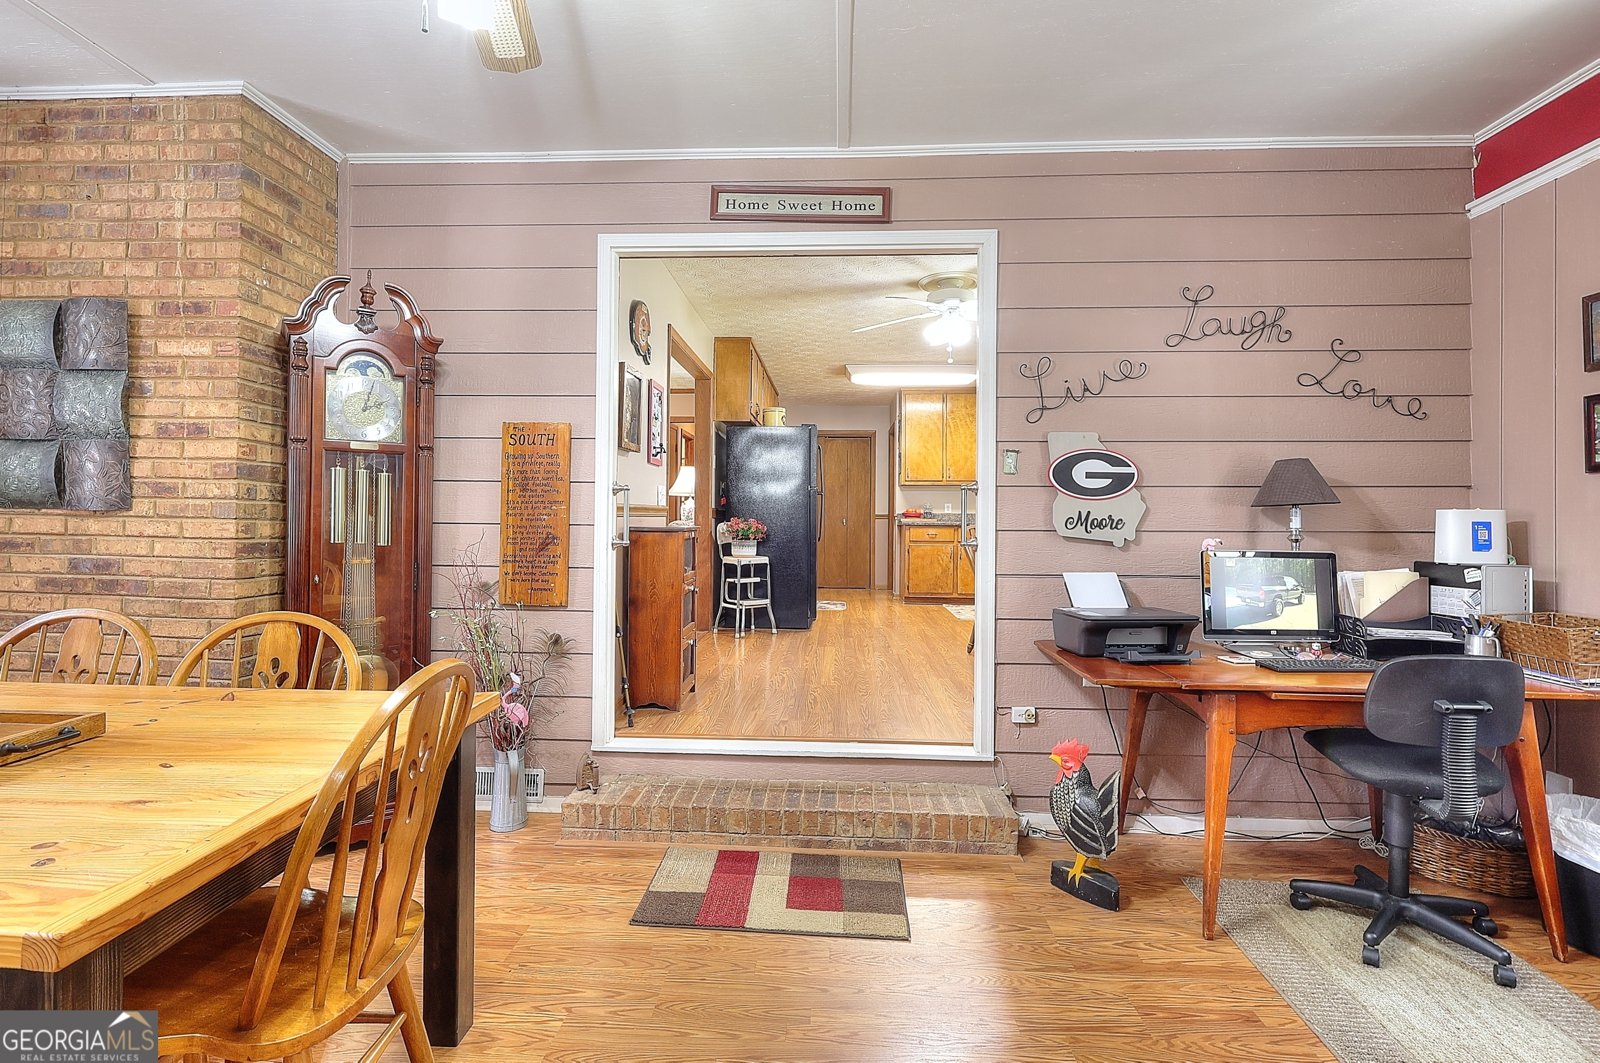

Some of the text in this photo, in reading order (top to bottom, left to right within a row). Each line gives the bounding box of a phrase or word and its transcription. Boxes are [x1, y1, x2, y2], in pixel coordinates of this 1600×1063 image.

[725, 199, 876, 211] Home Sweet Home
[1166, 285, 1292, 350] Laugh
[1020, 356, 1147, 424] Live
[1297, 338, 1428, 420] Love
[509, 434, 555, 446] SOUTH
[1065, 510, 1125, 534] Moore
